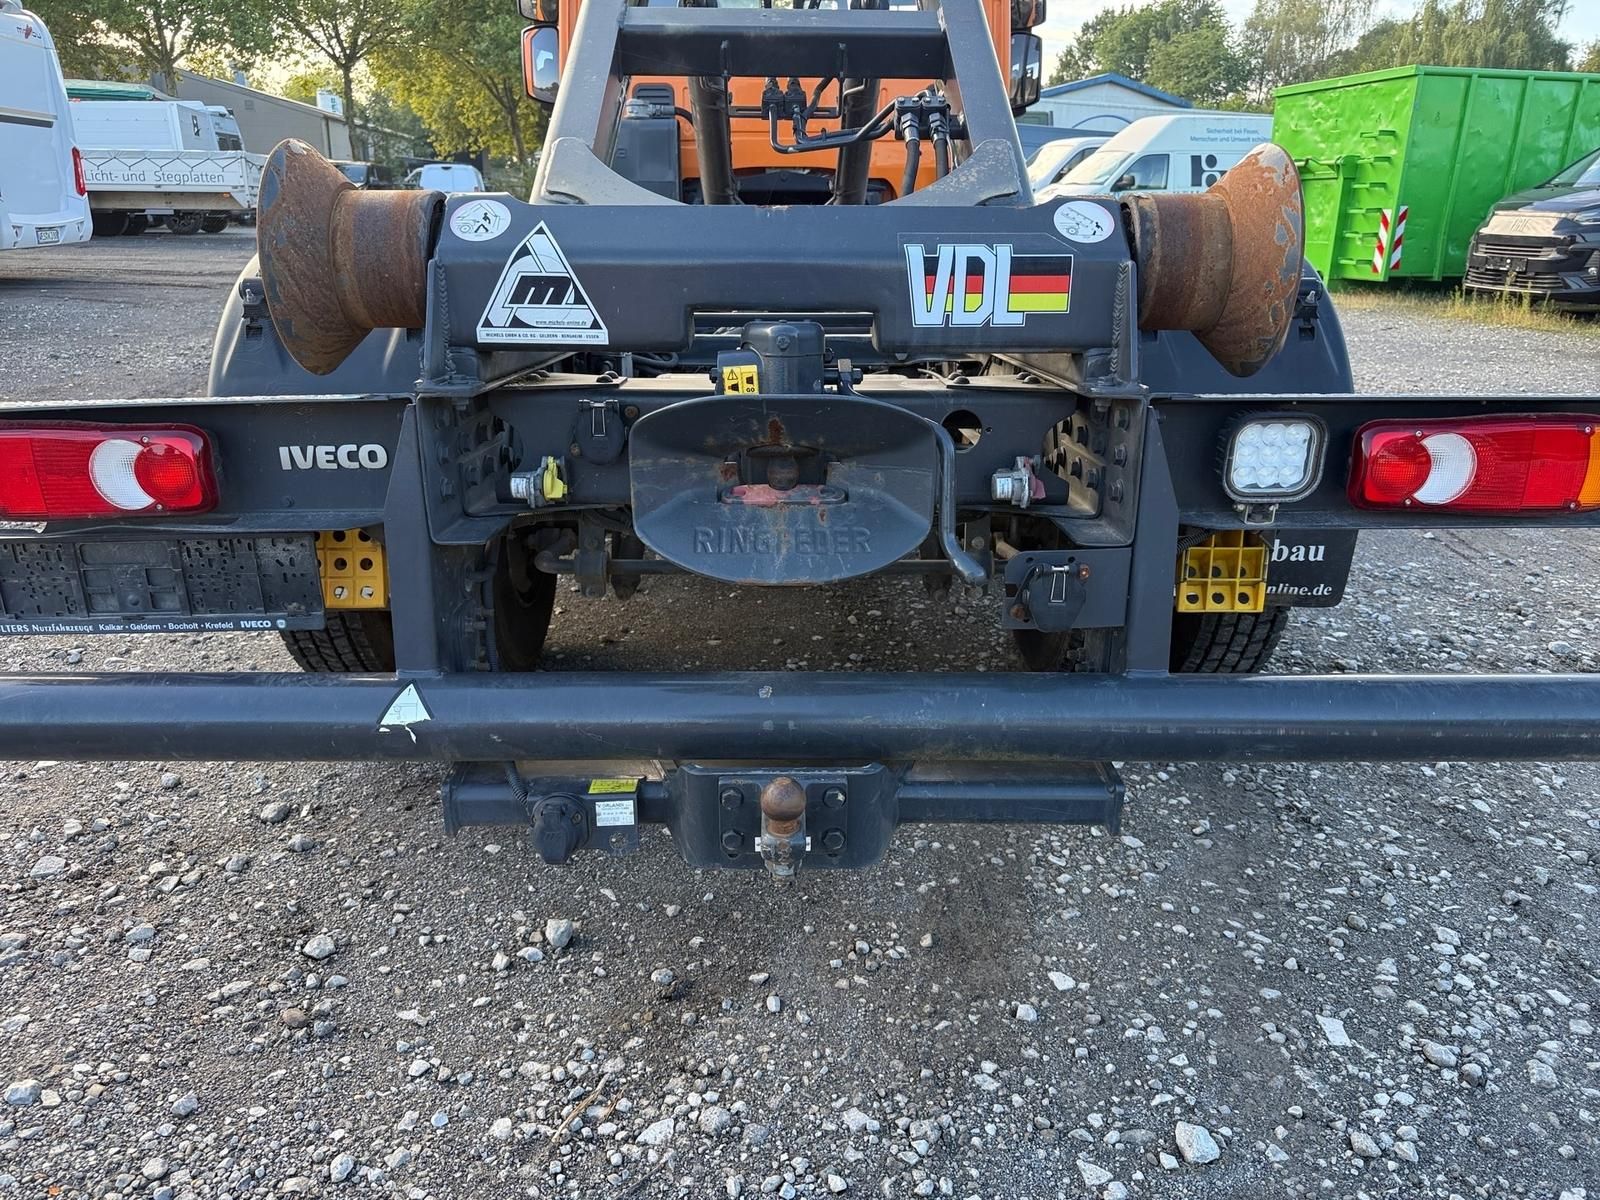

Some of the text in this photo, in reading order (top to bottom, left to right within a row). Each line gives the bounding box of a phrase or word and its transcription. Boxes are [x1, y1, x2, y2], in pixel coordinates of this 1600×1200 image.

[84, 169, 224, 185] Licht- und Stegplatten
[904, 243, 1026, 327] VDL
[278, 443, 388, 470] IVECO
[1271, 538, 1325, 562] bau
[1266, 583, 1332, 596] nline.de
[0, 624, 29, 633] LTERS
[99, 623, 123, 631] Kalkar
[130, 622, 161, 631] Geldern
[168, 622, 199, 630] Bocholt
[205, 621, 234, 630] Krefeld
[240, 620, 272, 628] IVECO
